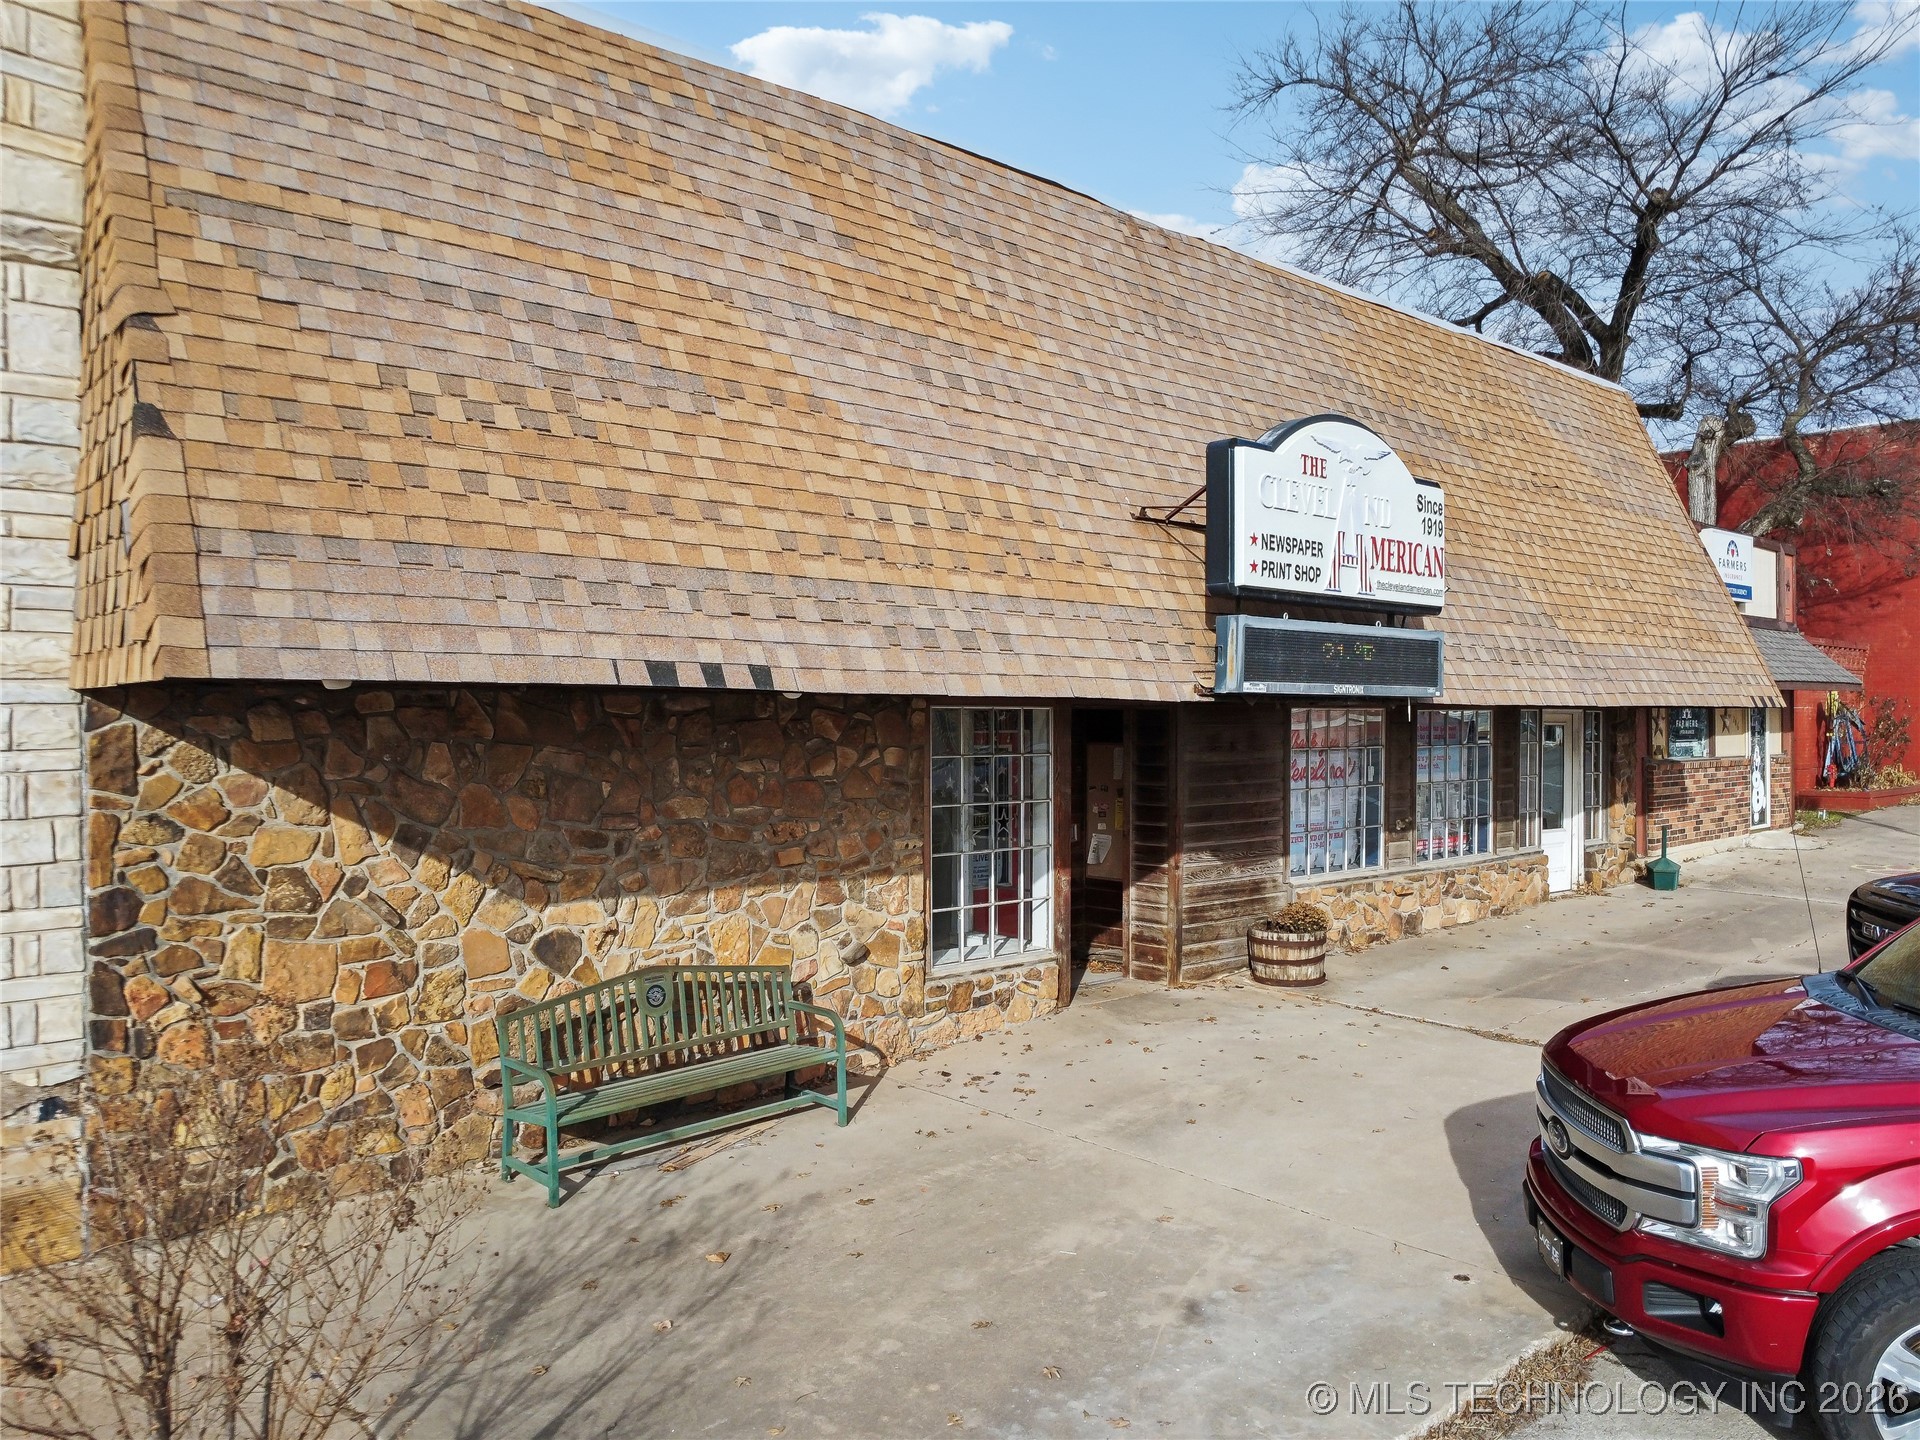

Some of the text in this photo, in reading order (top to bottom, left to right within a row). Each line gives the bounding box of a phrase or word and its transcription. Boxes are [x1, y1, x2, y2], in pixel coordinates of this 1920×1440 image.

[1301, 454, 1328, 479] THE
[1259, 474, 1392, 529] CLEVELAND
[1416, 494, 1444, 516] Since
[1421, 517, 1444, 538] 1919
[1261, 533, 1324, 558] NEWSPAPER
[1261, 560, 1322, 583] PRINT SHOP
[1718, 557, 1747, 572] FARMERS
[1333, 684, 1364, 695] SIGNTRONIX
[1675, 719, 1699, 728] FARMERS
[1862, 921, 1895, 941] GM
